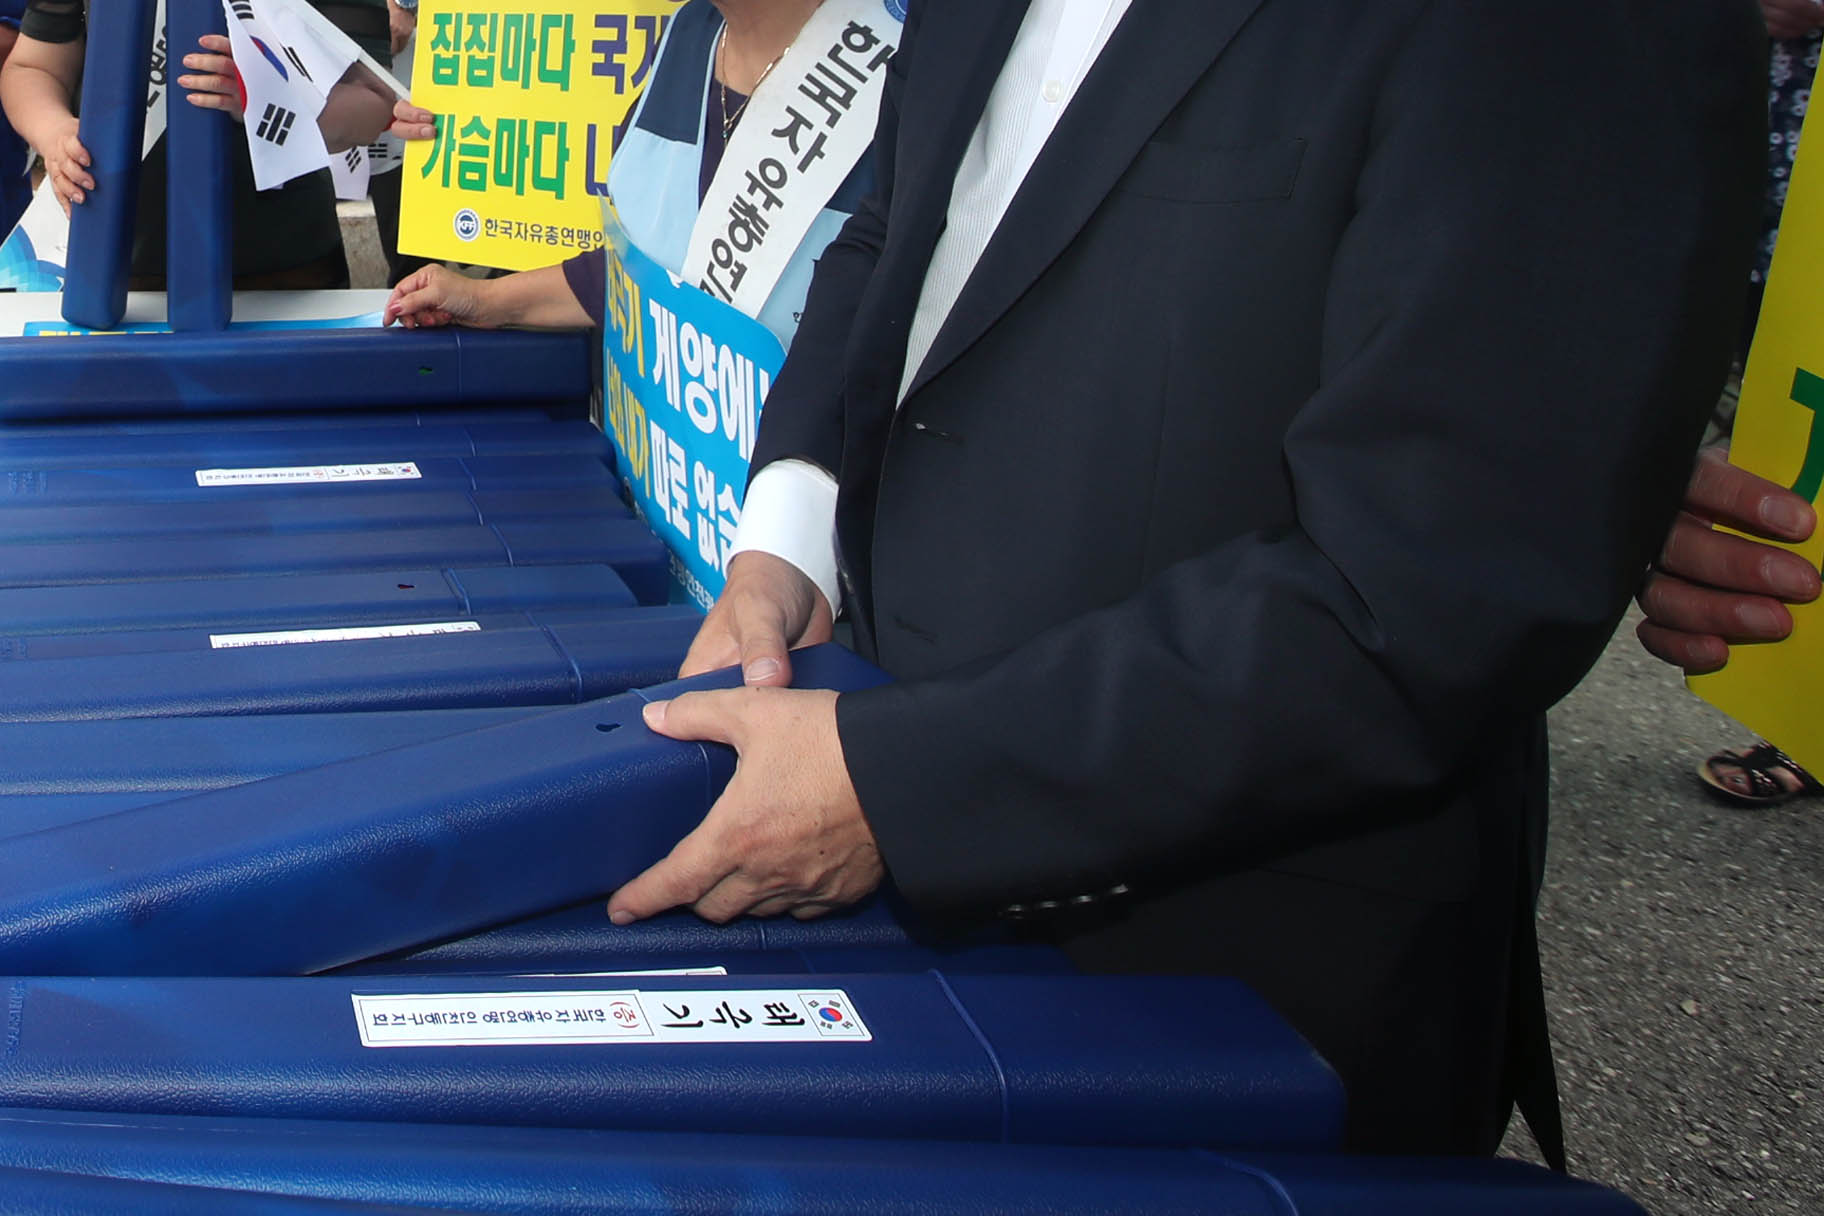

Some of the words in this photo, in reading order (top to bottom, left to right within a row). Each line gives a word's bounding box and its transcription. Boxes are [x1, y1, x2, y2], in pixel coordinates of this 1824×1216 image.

[430, 12, 576, 91] 집집마다
[421, 113, 570, 200] 가슴마다
[700, 19, 895, 304] 한국자유총연
[372, 1009, 477, 1026] 인천동구지회
[482, 1005, 606, 1025] 한국자유총연맹
[660, 1000, 806, 1029] 태극기
